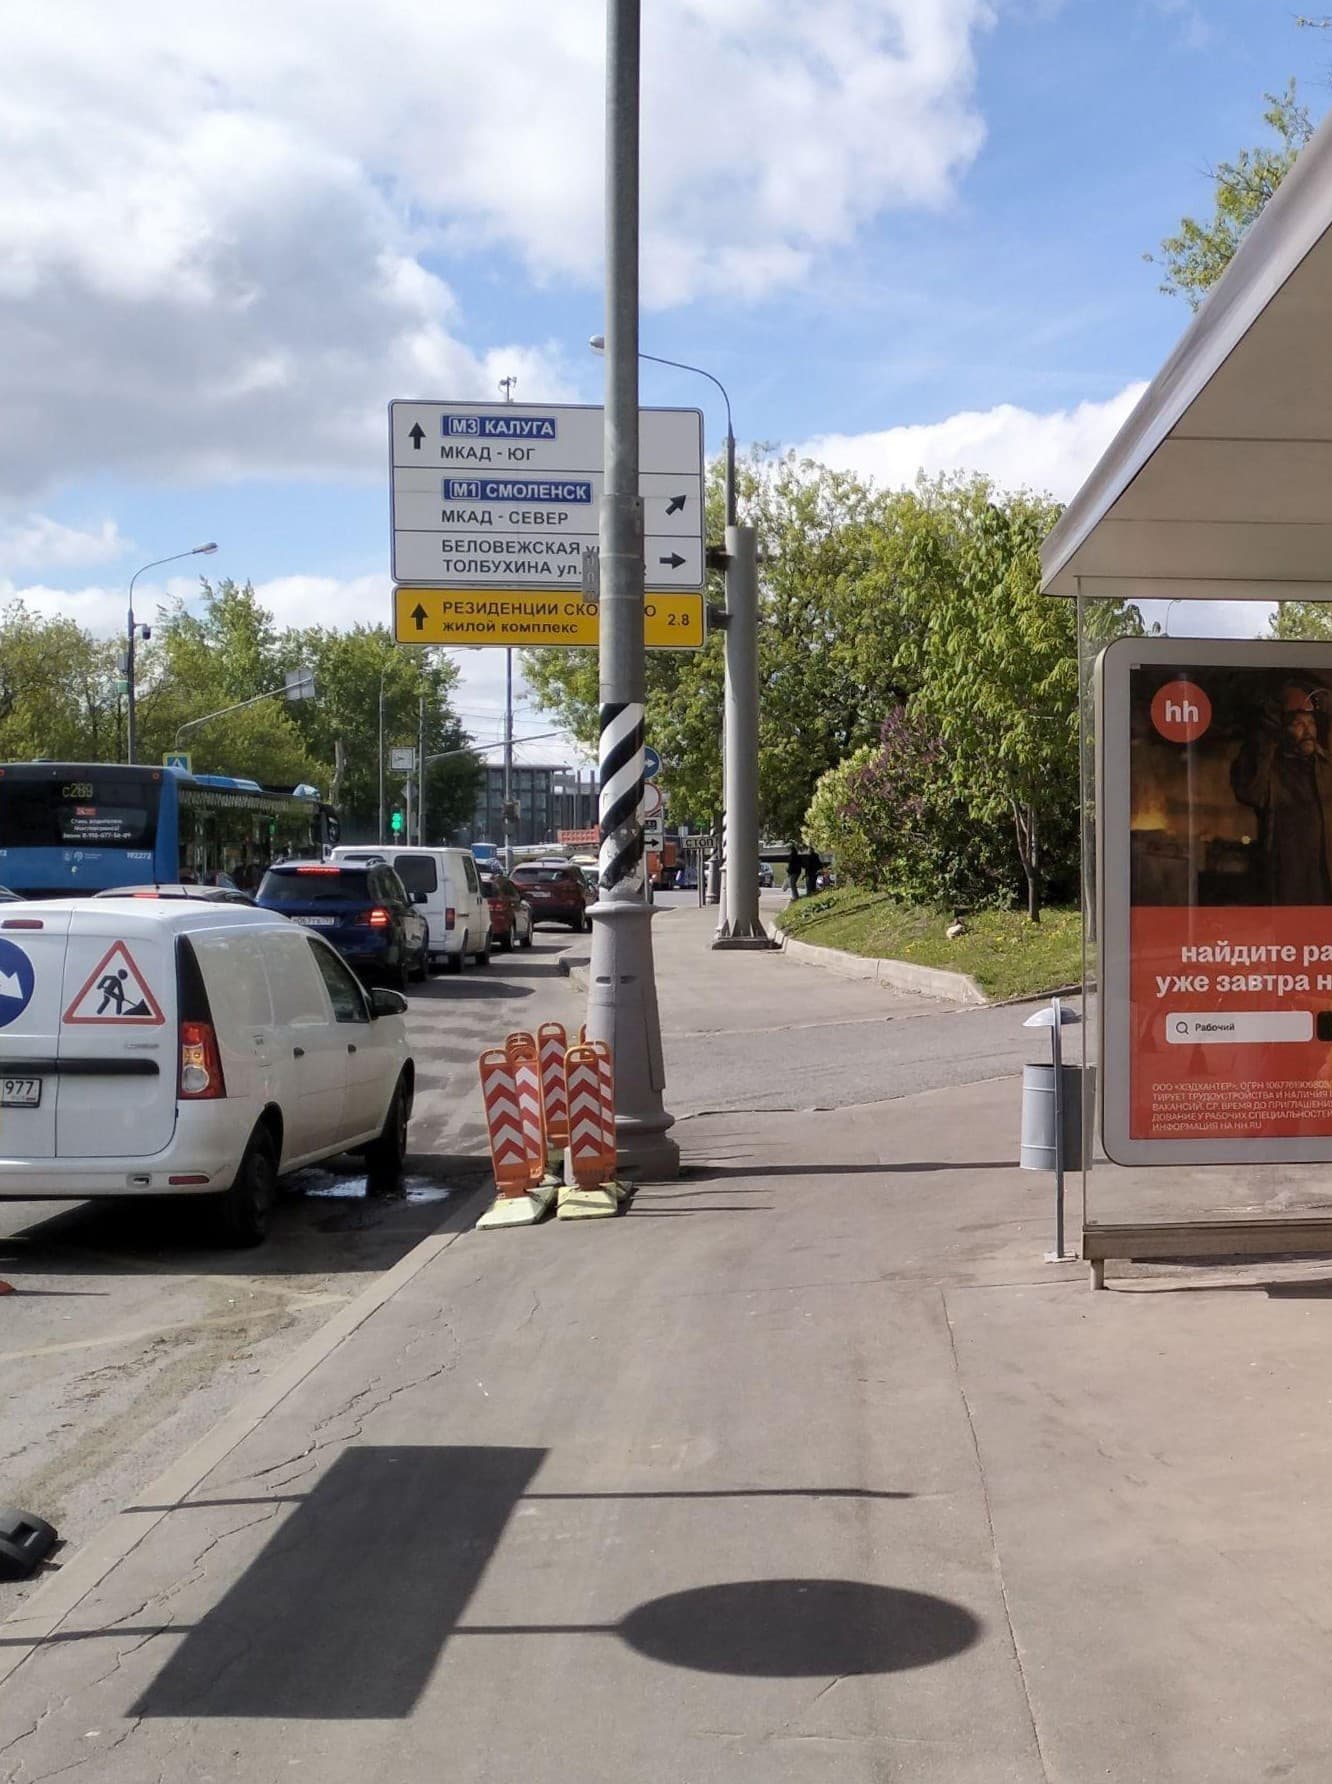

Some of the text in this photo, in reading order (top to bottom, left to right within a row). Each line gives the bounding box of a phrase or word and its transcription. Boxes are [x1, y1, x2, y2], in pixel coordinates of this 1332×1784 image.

[452, 419, 554, 436] М3 КАЛУГА
[440, 446, 492, 462] МКАД
[507, 448, 536, 461] ЮГ
[453, 483, 586, 499] М1 СМОЛЕНСК
[441, 510, 493, 526] МКАД
[508, 511, 568, 525] СЕВЕР
[442, 539, 580, 555] БЕЛОВЕЖСКАЯ
[443, 559, 582, 577] ТОЛБУХИНА ул.
[443, 601, 558, 616] РЕЗИДЕНЦИИ
[443, 619, 578, 634] жилой комплекс
[667, 613, 690, 626] 2.8
[1165, 699, 1199, 723] hh
[685, 838, 714, 847] СТОП
[1181, 940, 1297, 966] найдите
[1156, 975, 1209, 998] уже
[1216, 973, 1310, 996] завтра
[1195, 1022, 1235, 1033] Рабочий
[5, 1080, 34, 1095] 977
[1152, 1083, 1174, 1092] ООО
